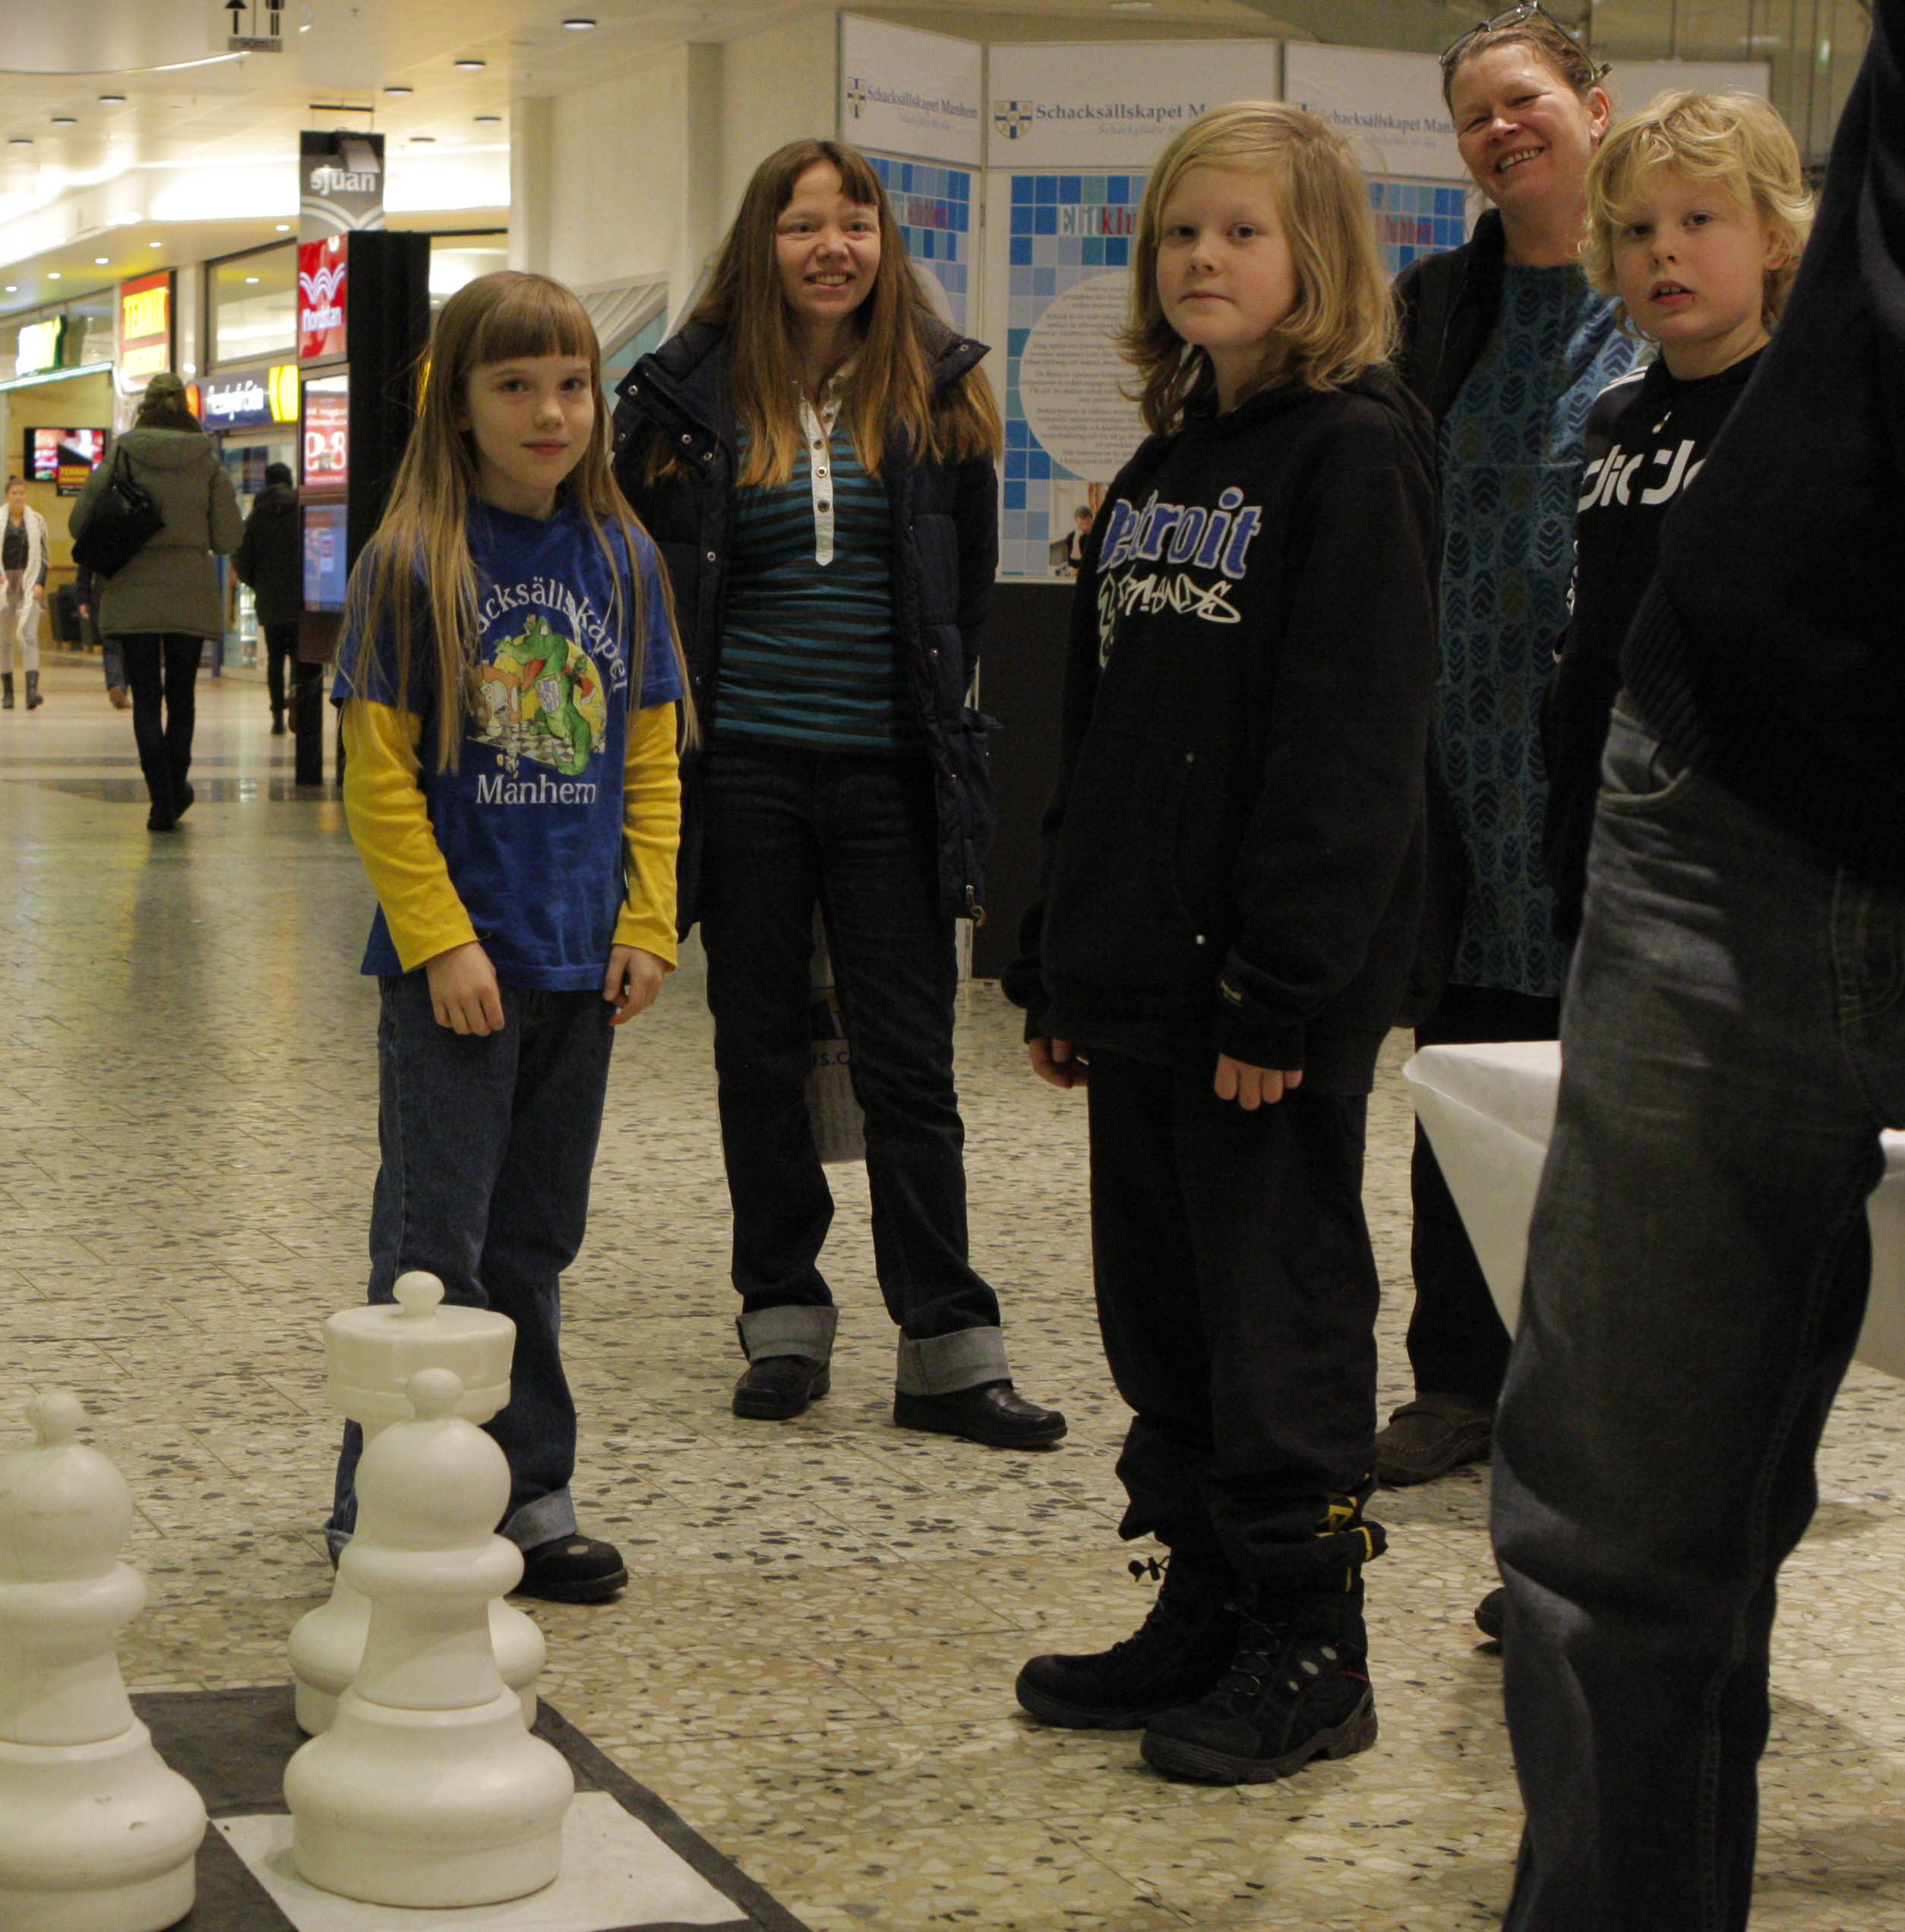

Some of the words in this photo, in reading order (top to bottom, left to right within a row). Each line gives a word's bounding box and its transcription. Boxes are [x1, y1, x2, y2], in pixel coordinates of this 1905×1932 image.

[1036, 103, 1183, 122] Schacksällskapet
[310, 164, 376, 196] sjuan
[476, 774, 596, 805] Manhem
